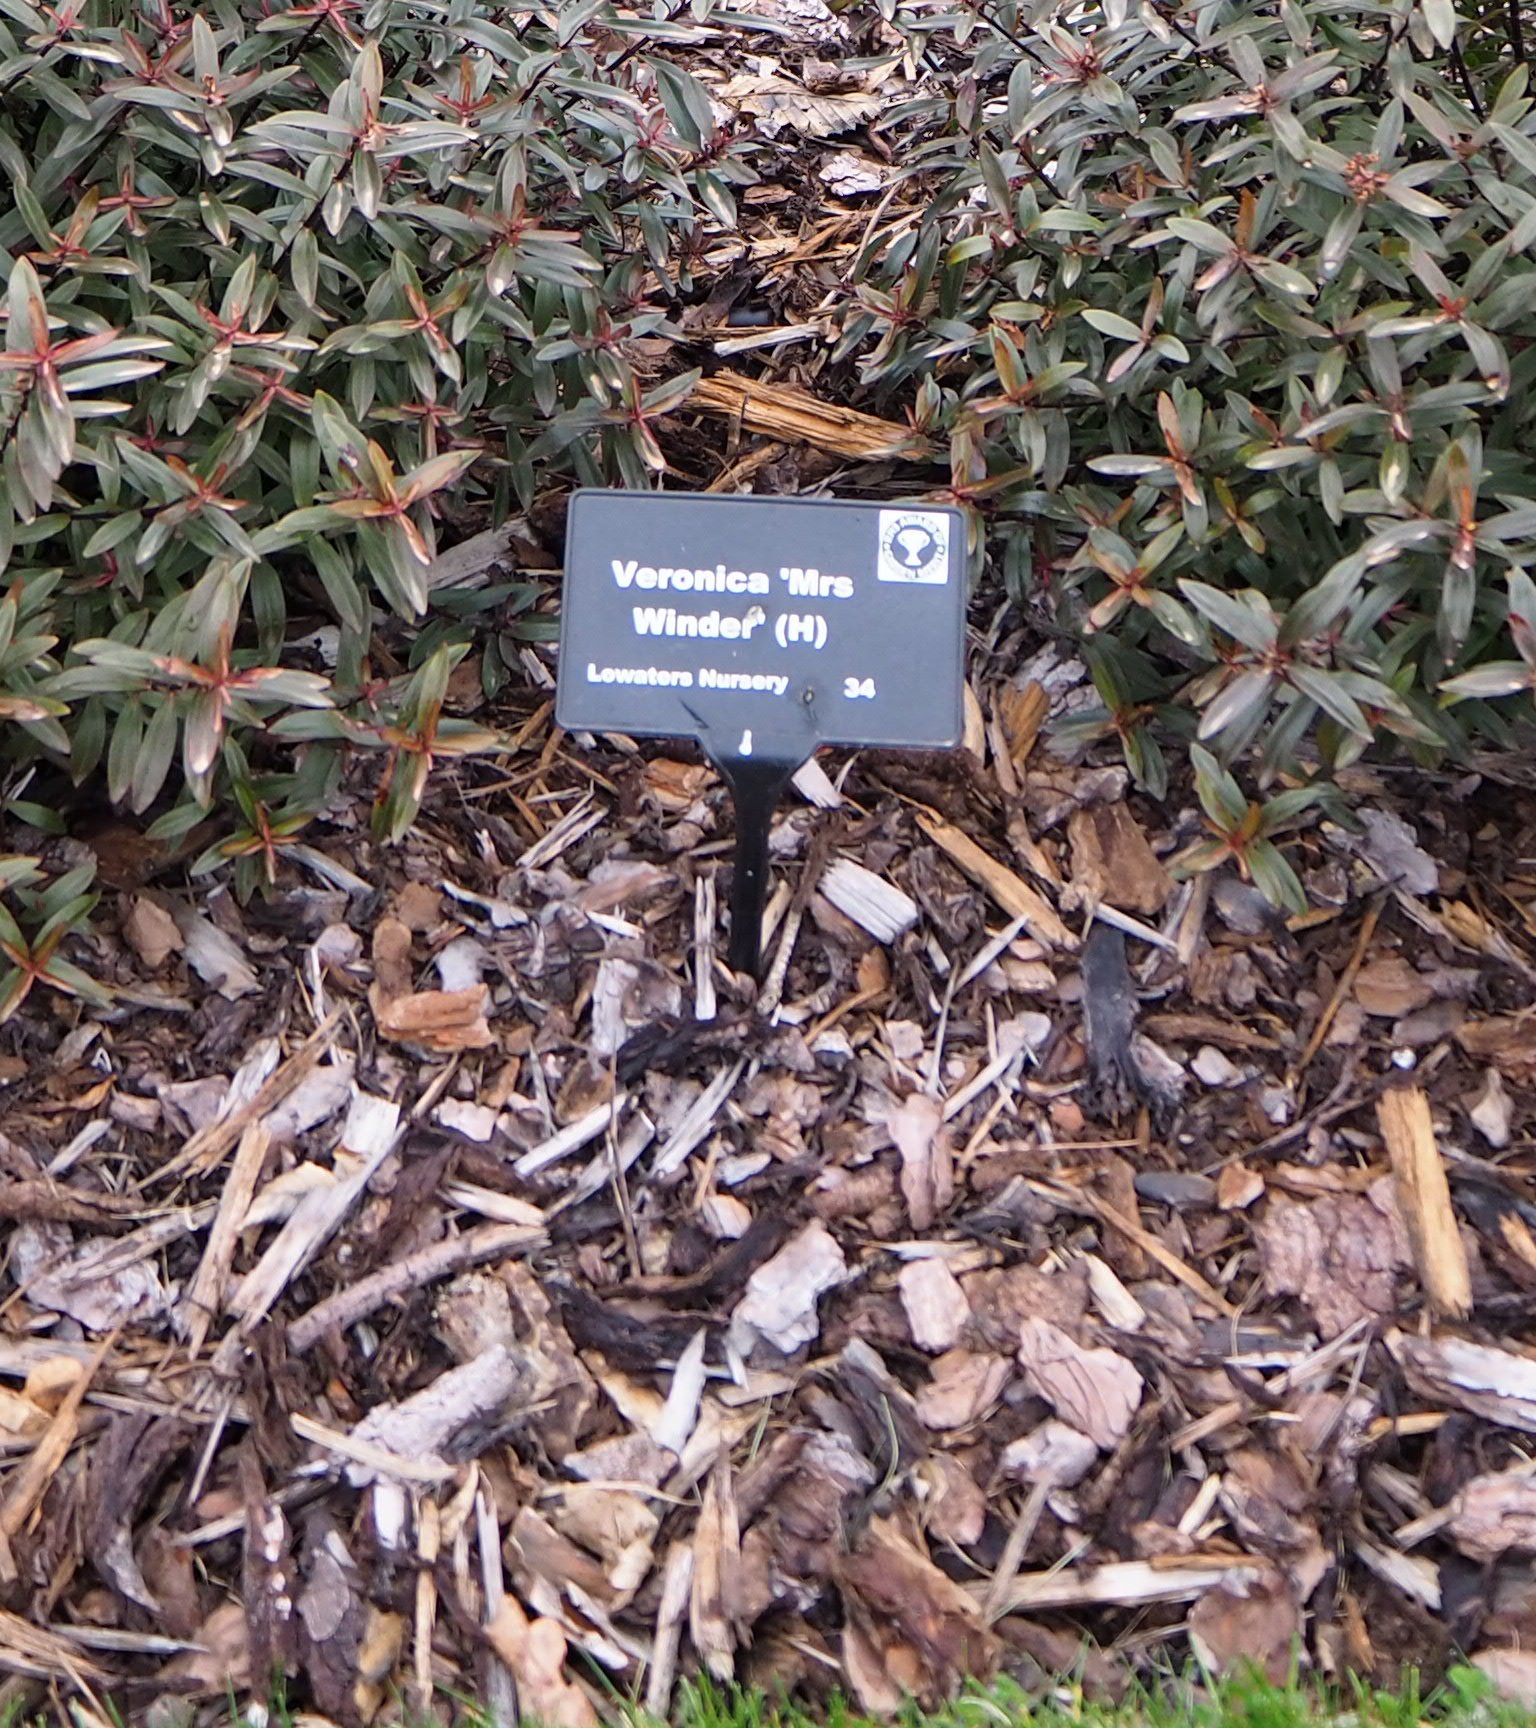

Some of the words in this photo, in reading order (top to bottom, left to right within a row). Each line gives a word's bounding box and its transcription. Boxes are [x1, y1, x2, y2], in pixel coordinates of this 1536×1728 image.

[611, 560, 769, 594] Veronica
[779, 567, 854, 599] 'Mrs
[632, 607, 765, 640] Winder'
[774, 614, 827, 649] (H)
[586, 663, 693, 688] Lowaters
[698, 668, 789, 695] Nursery
[843, 677, 876, 699] 34
